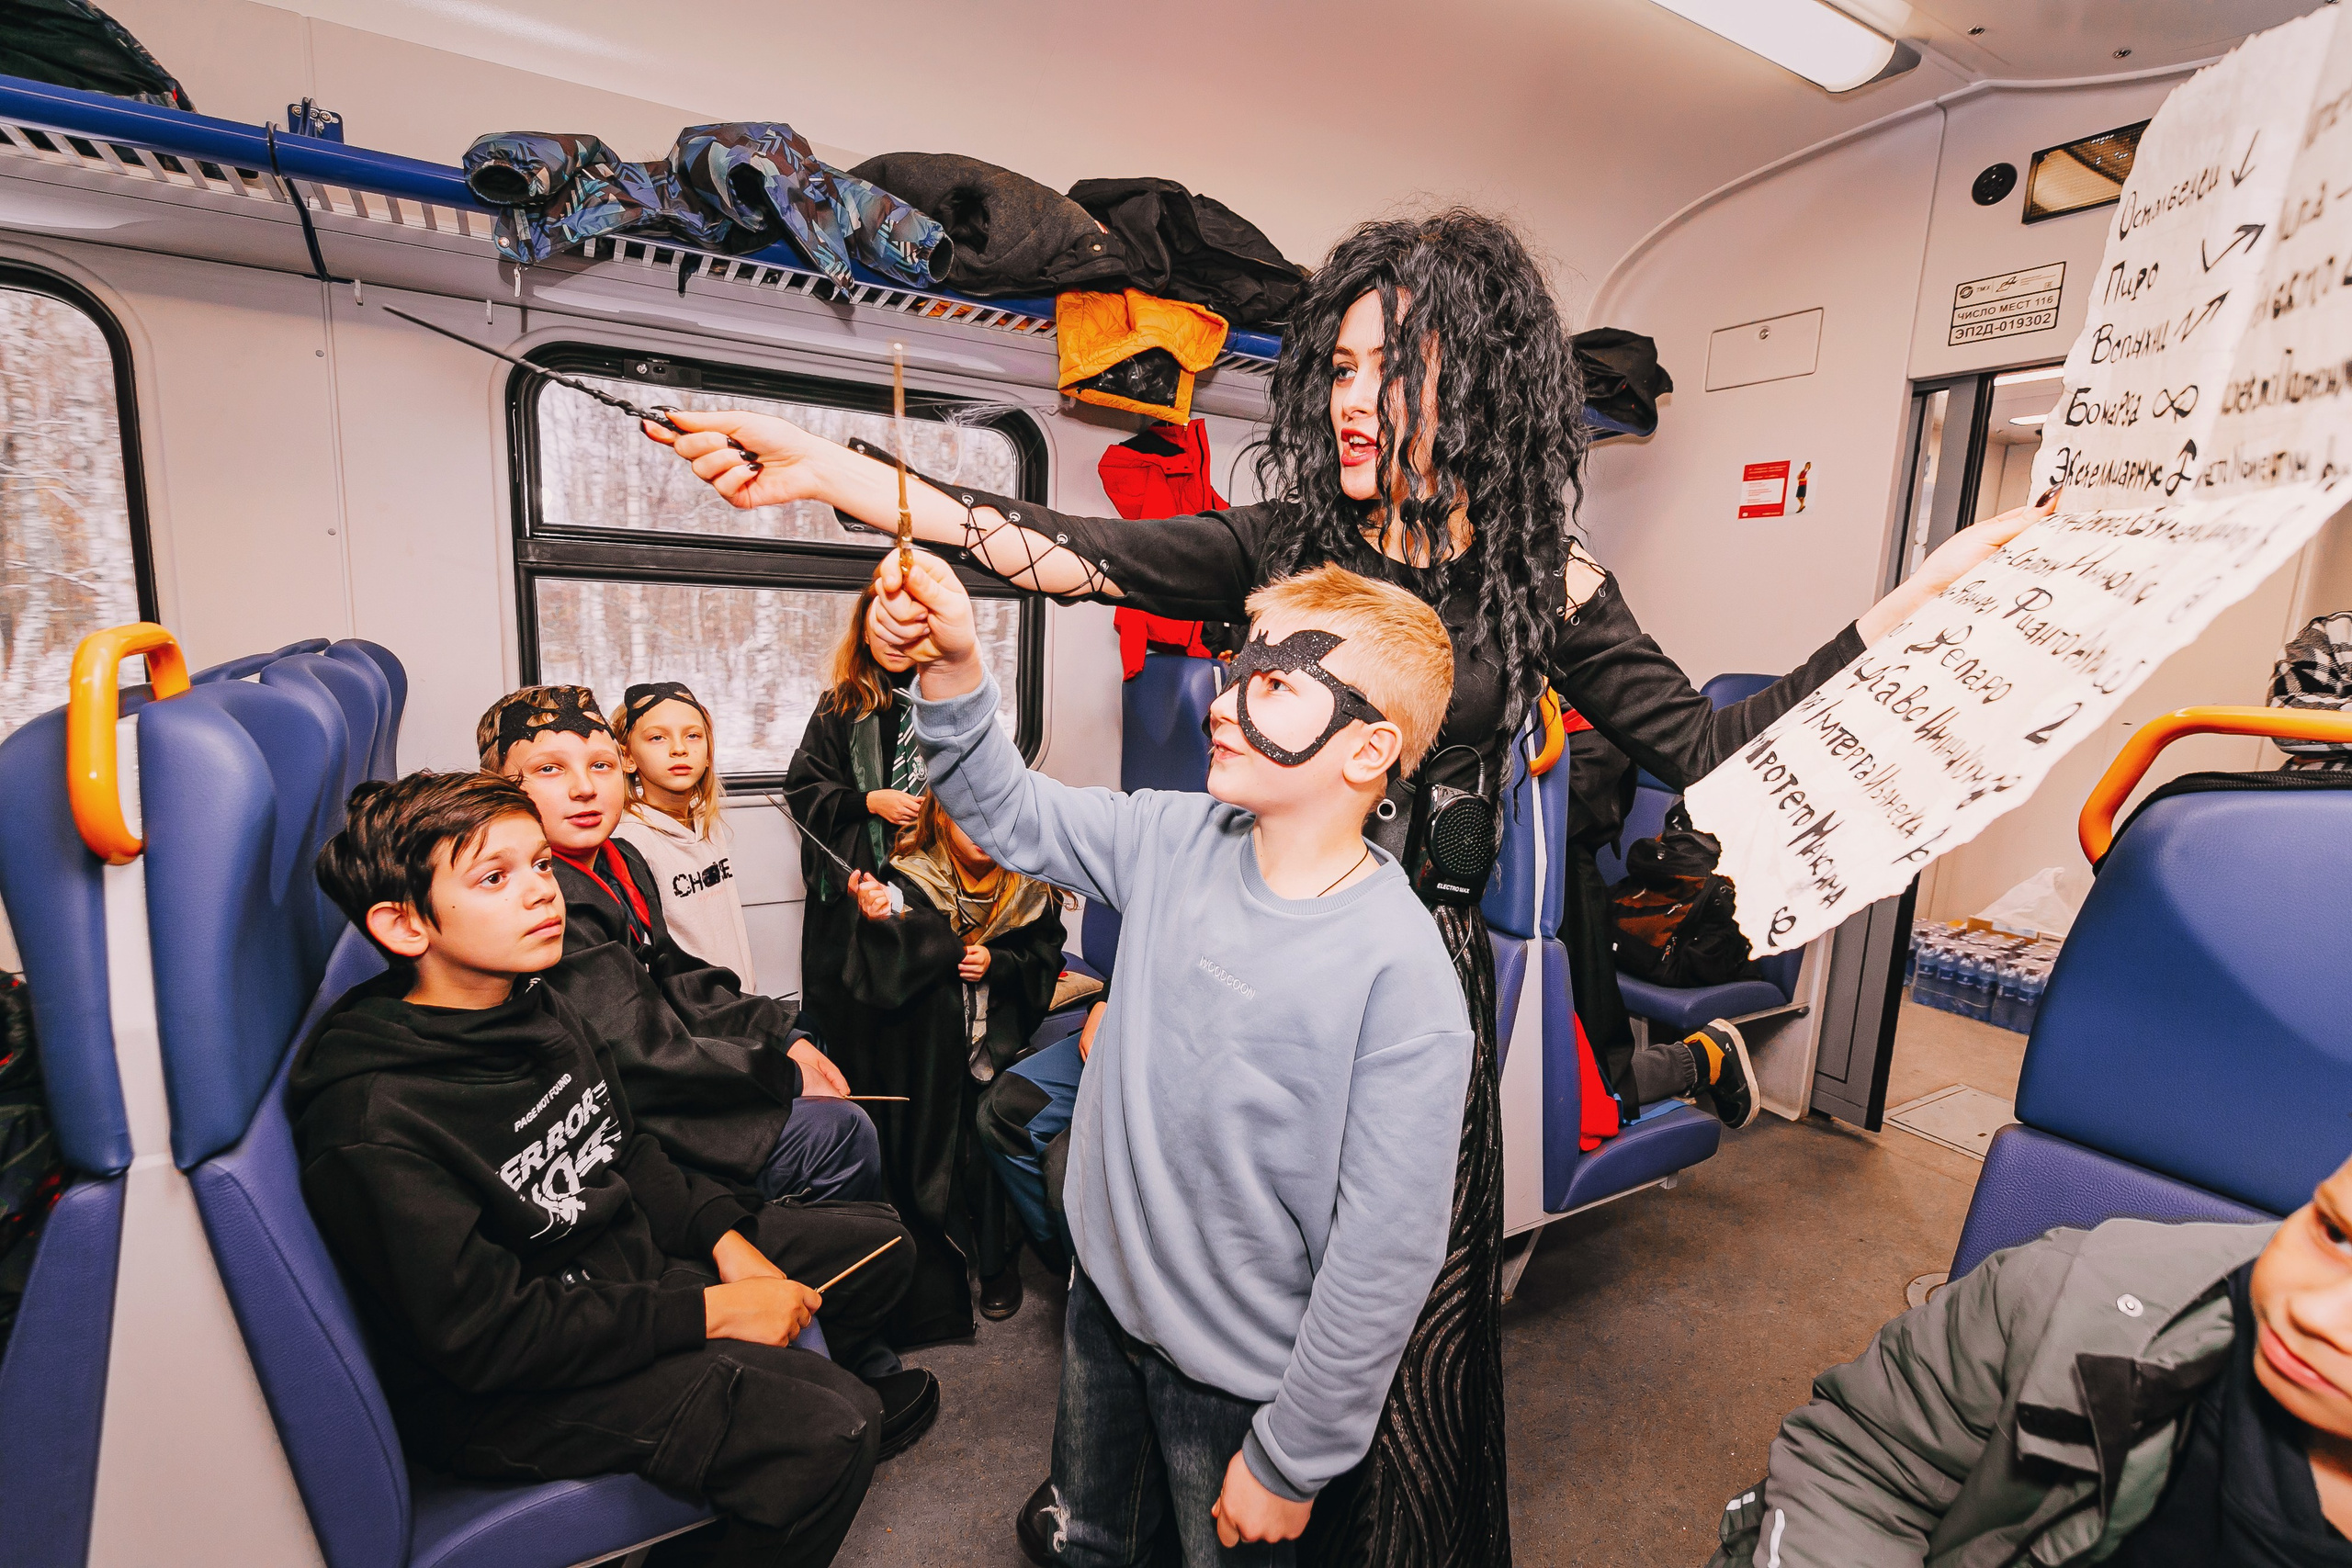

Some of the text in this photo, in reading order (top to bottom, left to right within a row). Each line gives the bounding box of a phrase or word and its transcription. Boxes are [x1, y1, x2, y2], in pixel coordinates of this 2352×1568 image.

[2103, 261, 2159, 306] Пиро
[1955, 312, 2052, 339] ЭП2Д-019302
[1957, 295, 2053, 320] ЧИСЛО МЕСТ 116
[1199, 955, 1256, 1000] WOODCOON
[514, 1073, 572, 1133] PAGE NOT FOUND
[496, 1084, 603, 1192] ERROR
